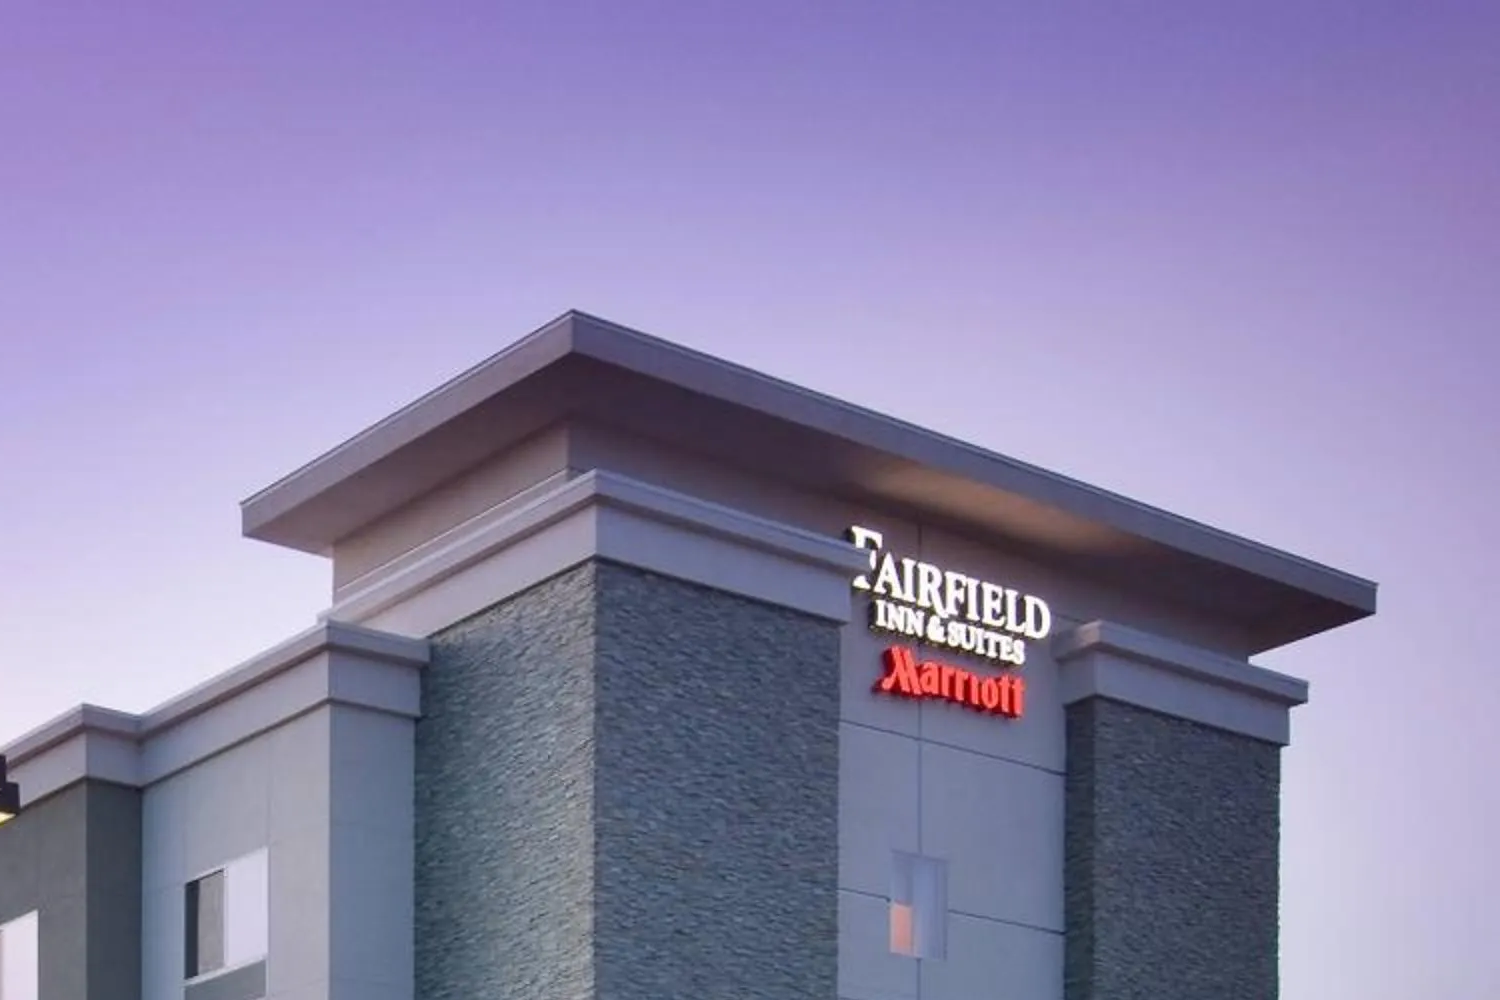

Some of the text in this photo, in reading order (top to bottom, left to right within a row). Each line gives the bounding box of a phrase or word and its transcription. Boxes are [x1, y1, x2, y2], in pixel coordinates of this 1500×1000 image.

[875, 600, 1025, 665] INN & SUITES
[881, 645, 1025, 716] Marriott
